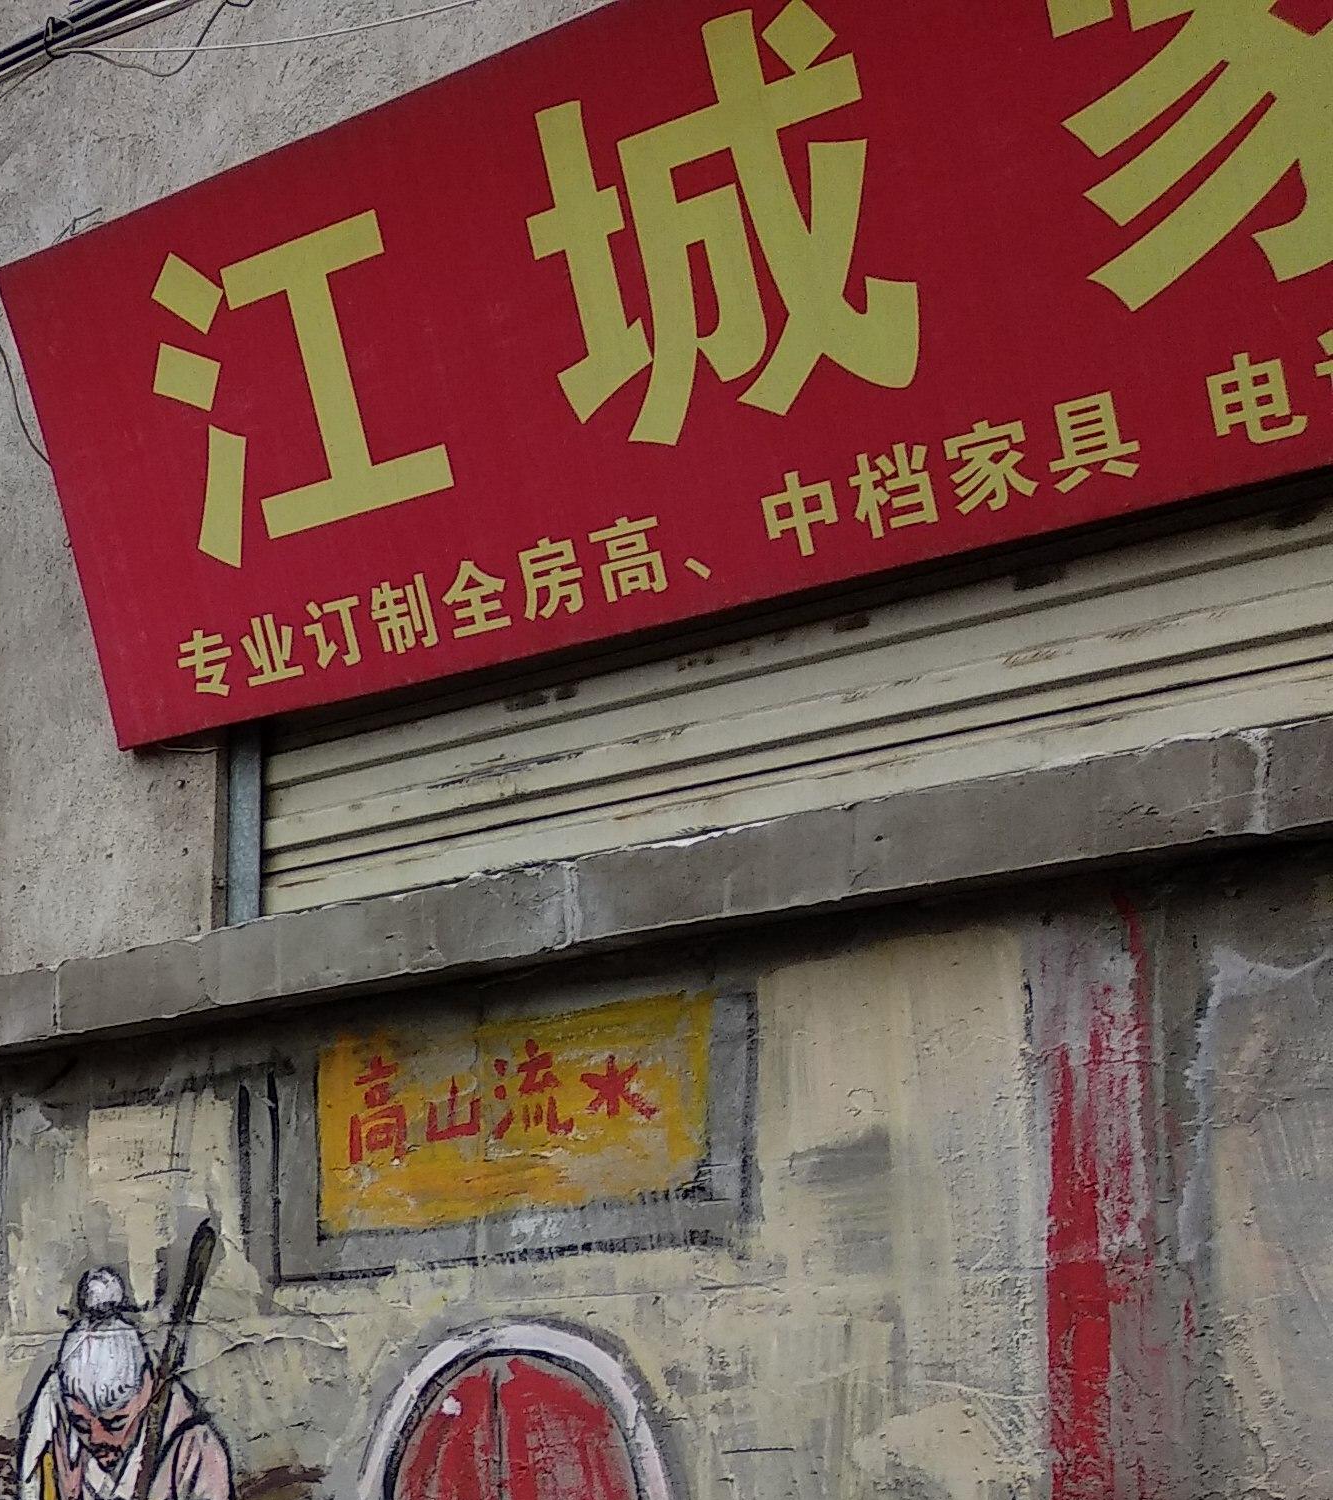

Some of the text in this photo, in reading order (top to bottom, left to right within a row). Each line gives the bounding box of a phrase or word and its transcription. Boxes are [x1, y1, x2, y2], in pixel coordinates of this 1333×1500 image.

[1205, 329, 1333, 444] 电
[348, 1038, 660, 1166] 高山流水
